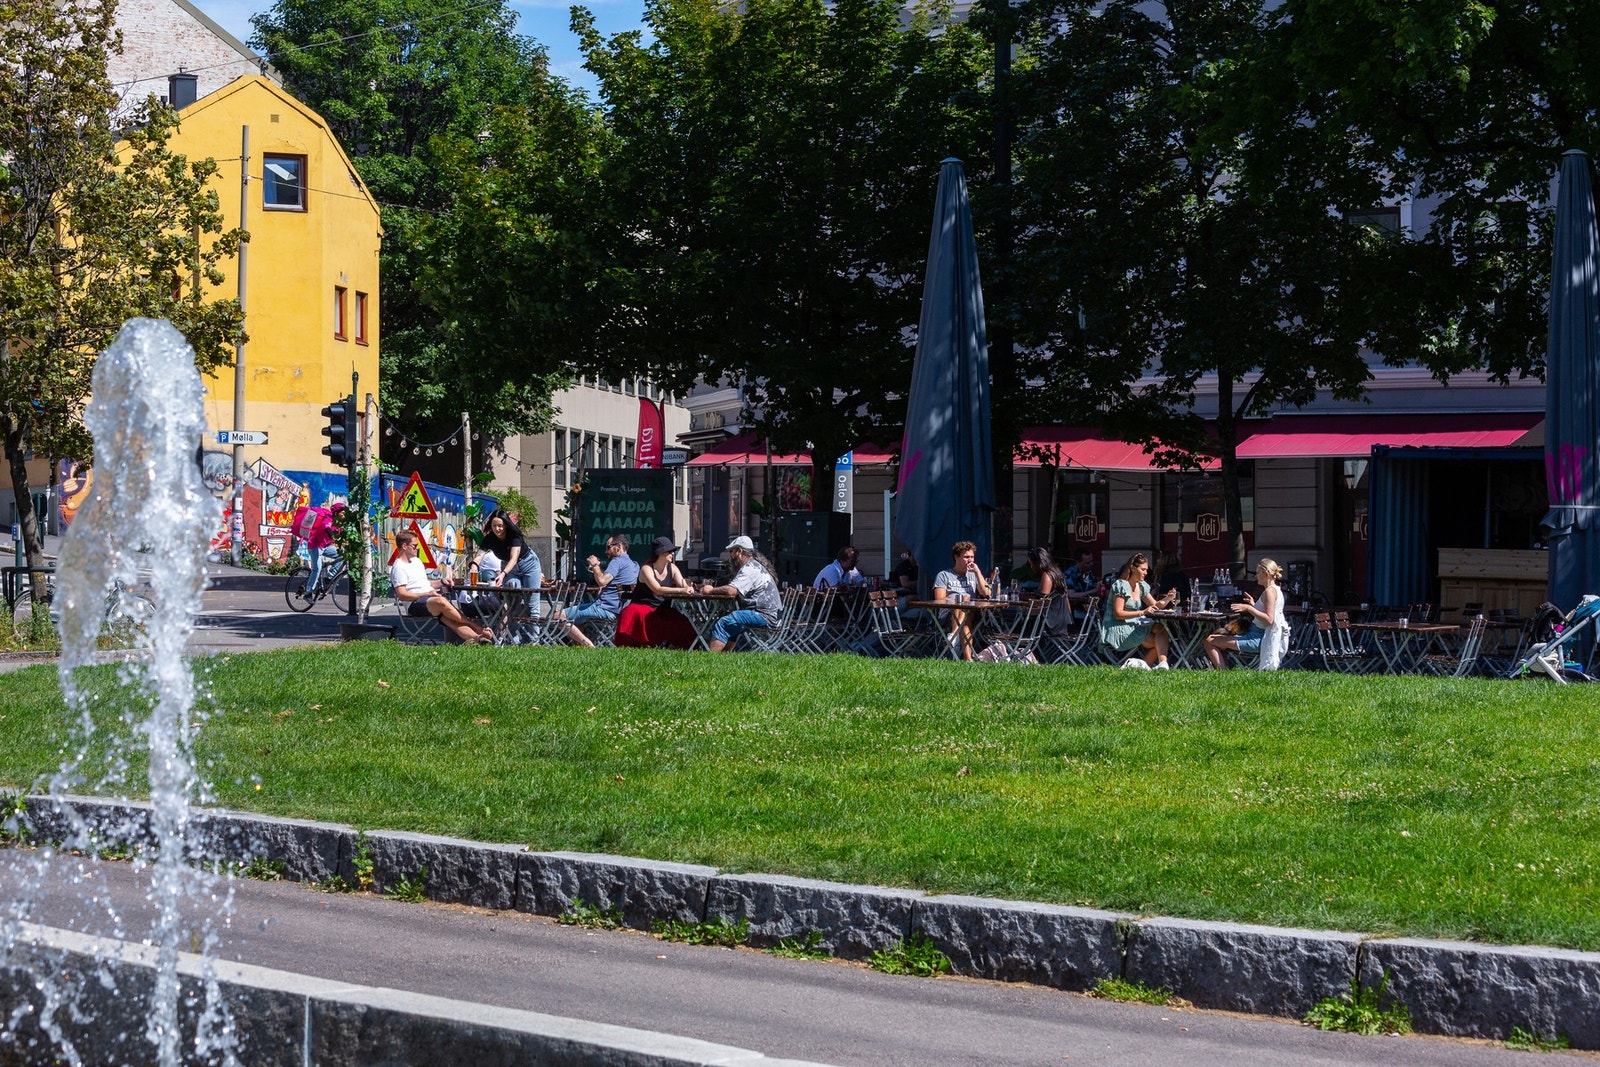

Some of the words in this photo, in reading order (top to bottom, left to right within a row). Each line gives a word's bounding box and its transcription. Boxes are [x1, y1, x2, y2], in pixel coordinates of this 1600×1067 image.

[231, 432, 254, 441] Mølla
[838, 475, 847, 498] Oslo
[590, 501, 656, 513] JAAADDA
[592, 517, 654, 529] AAAAAA
[1078, 519, 1094, 537] deli
[1200, 518, 1216, 536] deli
